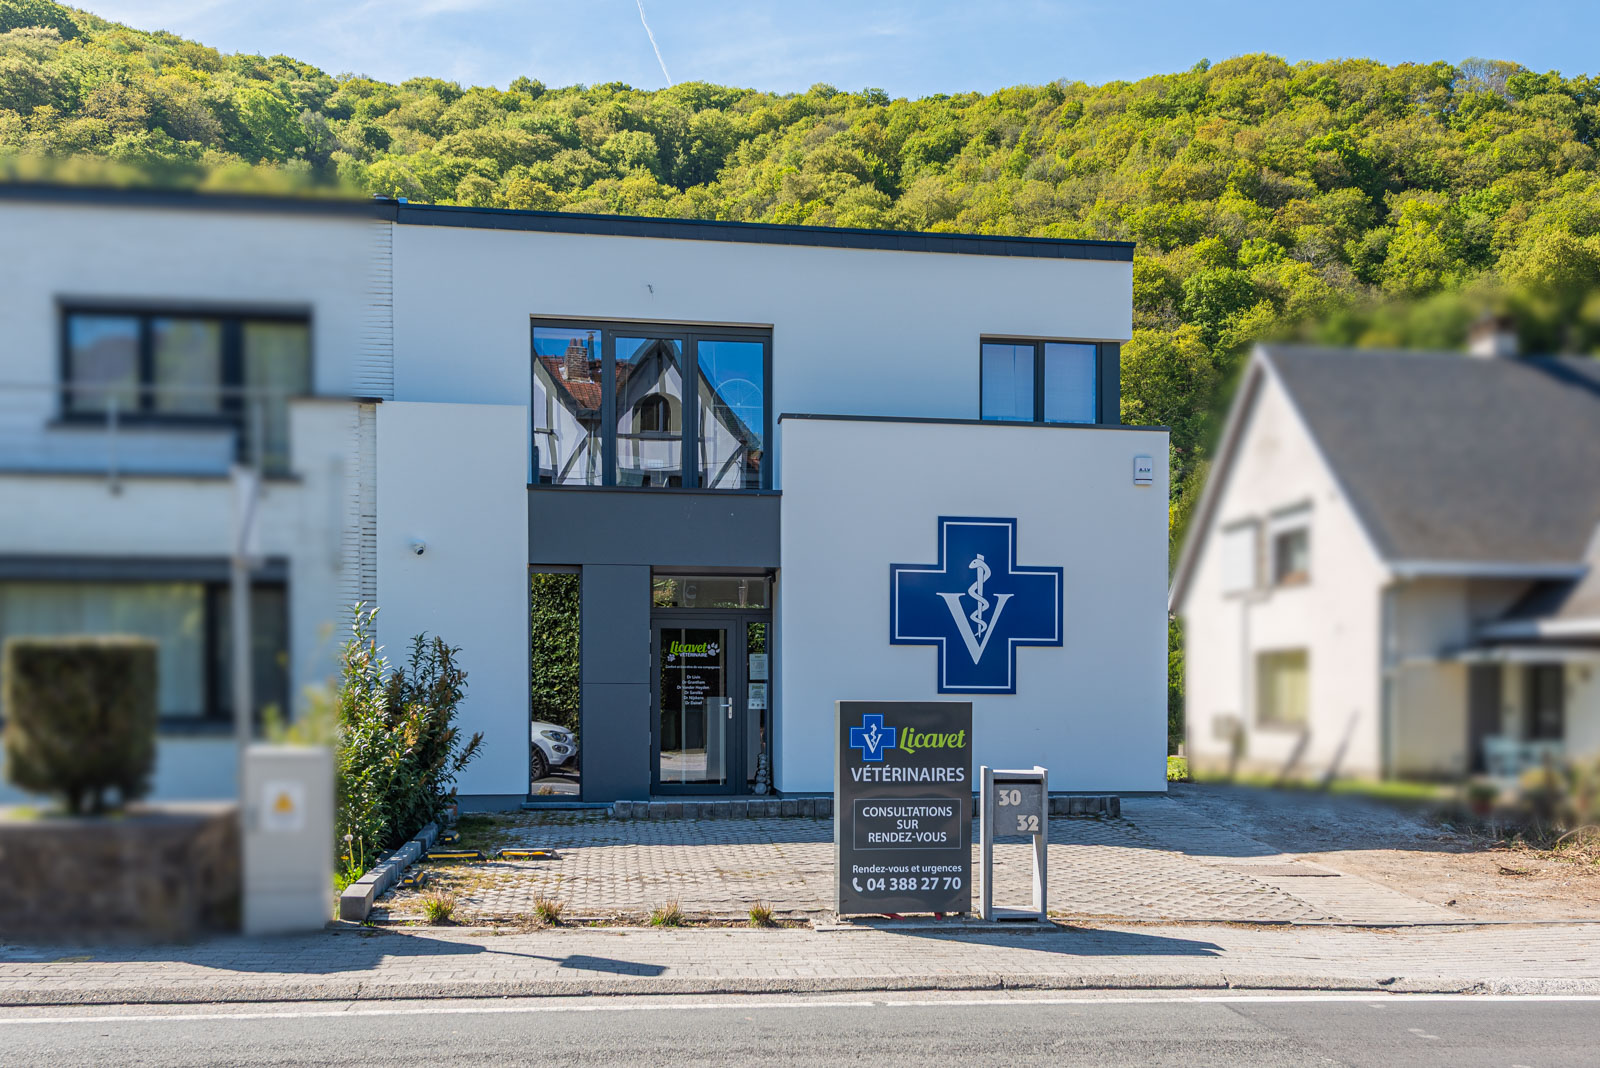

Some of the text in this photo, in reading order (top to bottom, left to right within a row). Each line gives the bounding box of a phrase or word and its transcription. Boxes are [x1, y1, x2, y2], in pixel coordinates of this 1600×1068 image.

[670, 640, 708, 656] Licavet
[899, 727, 967, 755] Licavet
[850, 764, 965, 782] VÉTÉRINAIRES
[998, 789, 1022, 806] 30
[862, 806, 953, 818] CONSULTATIONS
[896, 819, 919, 830] SUR
[1016, 814, 1039, 832] 32
[868, 832, 947, 843] RENDEZ-VOUS
[852, 864, 962, 875] Rendez-vous et urgences
[866, 876, 962, 891] 04 388 27 70
